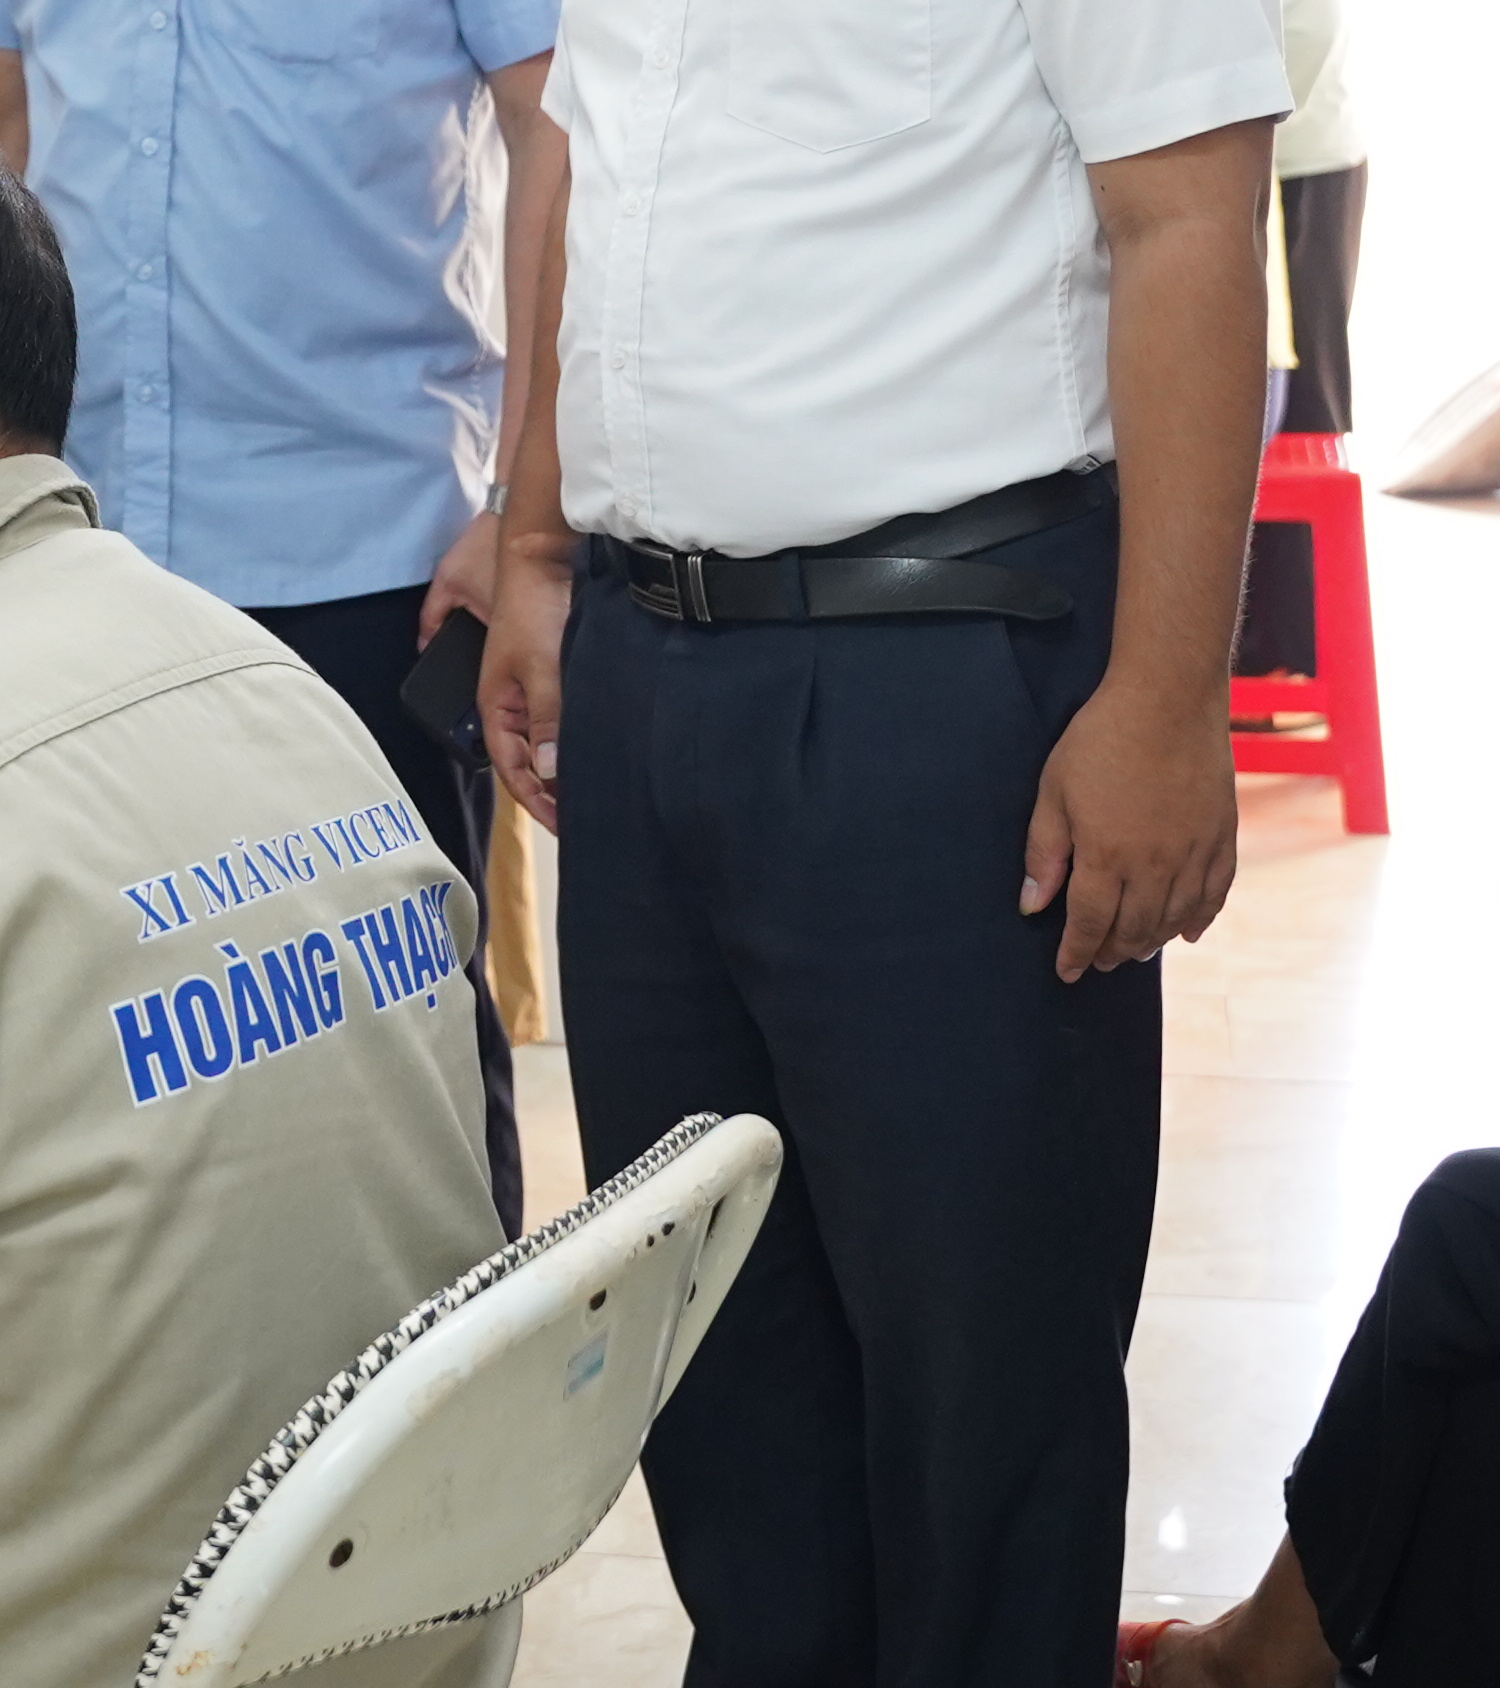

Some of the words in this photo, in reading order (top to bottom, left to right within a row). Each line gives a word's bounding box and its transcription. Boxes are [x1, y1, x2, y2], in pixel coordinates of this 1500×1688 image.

[122, 870, 195, 942] XI
[188, 832, 317, 918] MĂNG
[310, 799, 422, 877] VICEM
[110, 931, 346, 1108] HOÀNG
